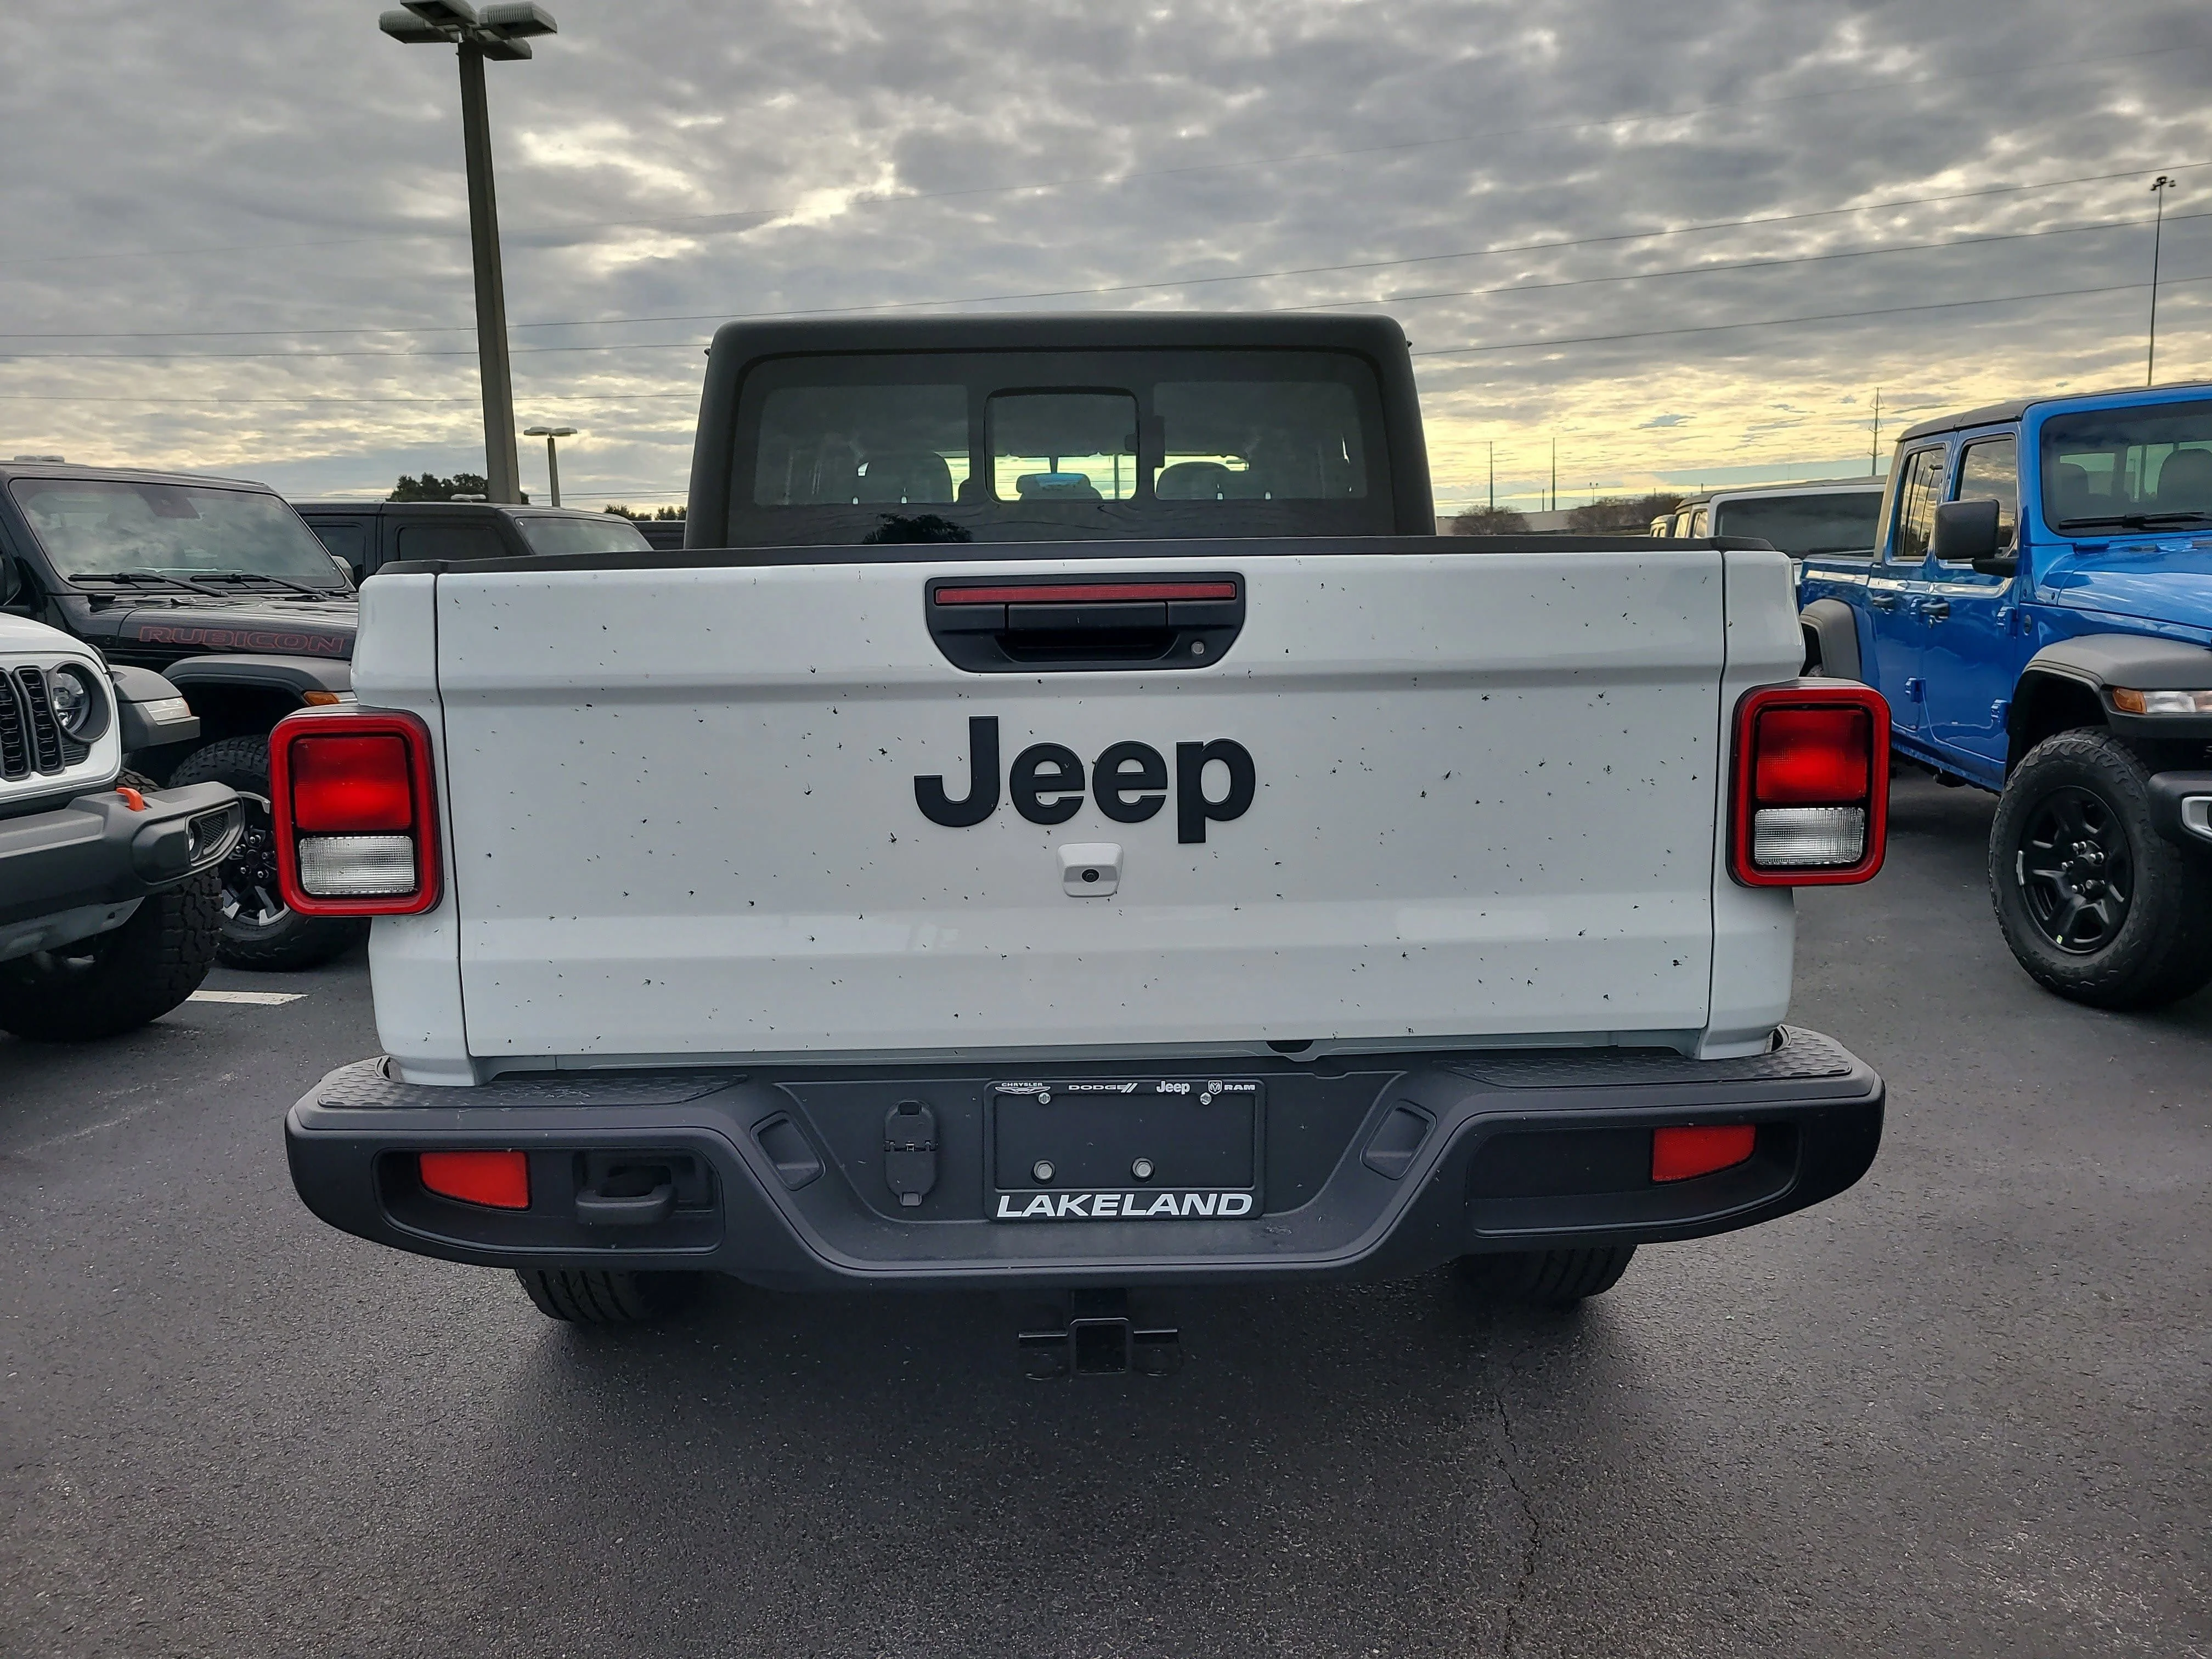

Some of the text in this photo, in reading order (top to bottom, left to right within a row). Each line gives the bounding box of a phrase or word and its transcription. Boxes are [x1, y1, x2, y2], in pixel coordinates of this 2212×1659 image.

[139, 625, 345, 653] RUBICON
[913, 715, 1256, 844] Jeep
[1156, 1080, 1190, 1095] Jeep
[996, 1193, 1253, 1217] LAKELAND
